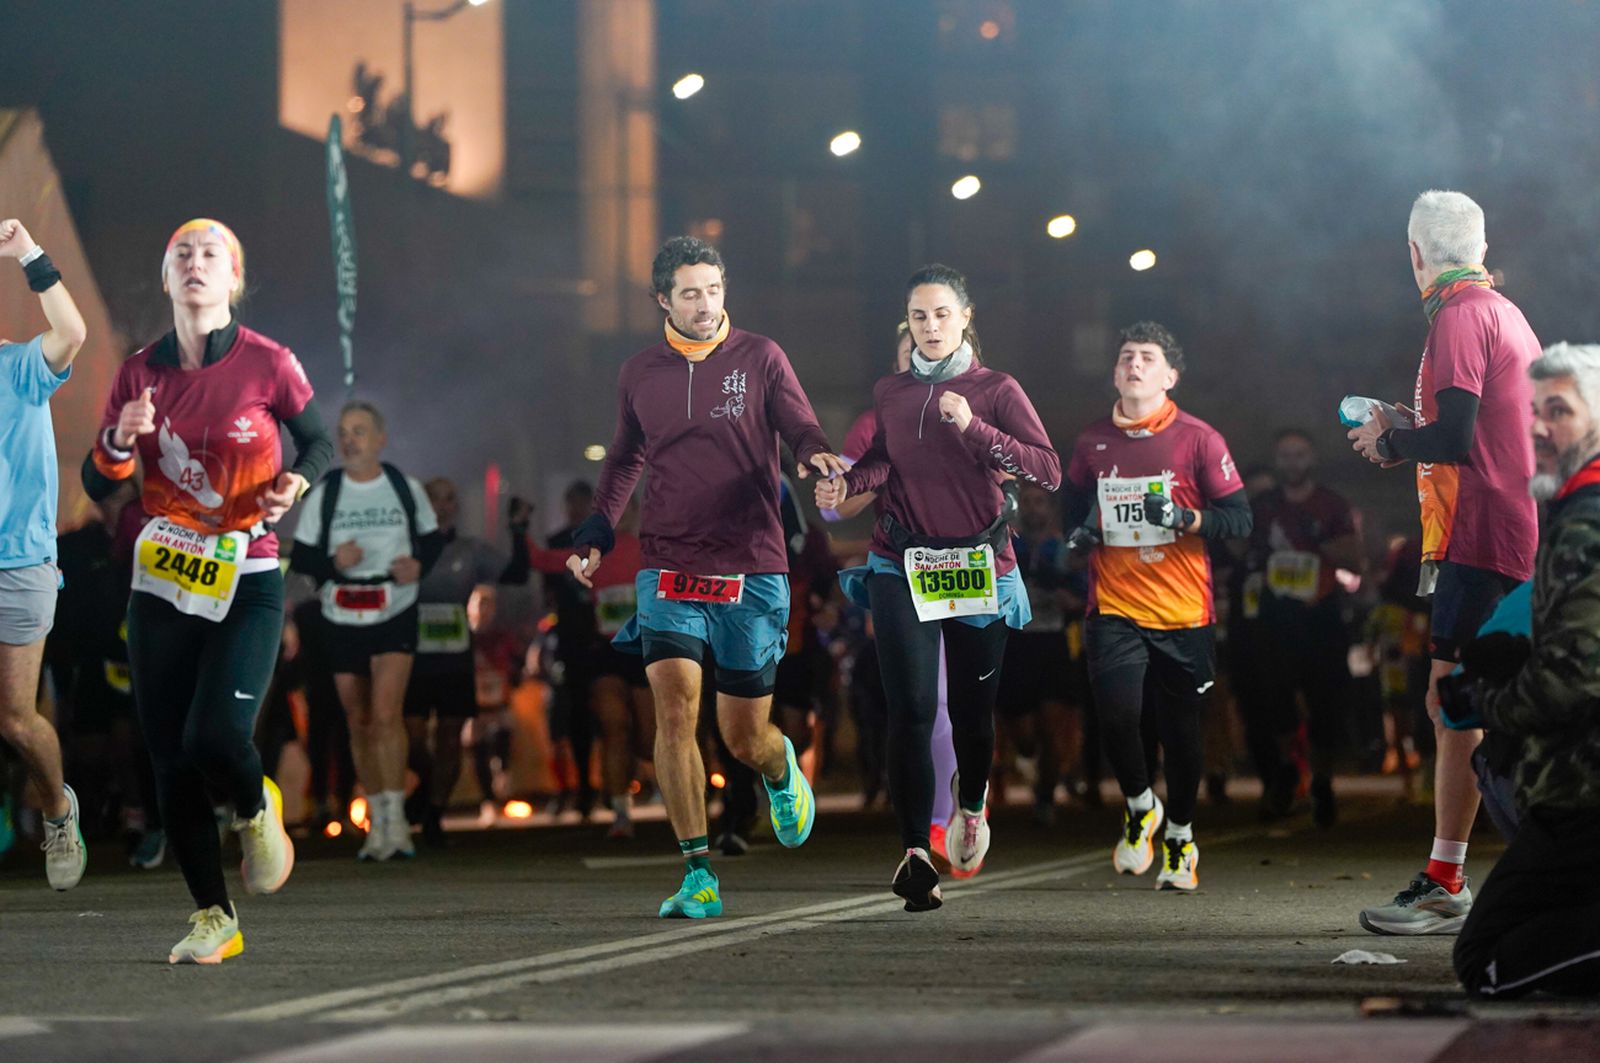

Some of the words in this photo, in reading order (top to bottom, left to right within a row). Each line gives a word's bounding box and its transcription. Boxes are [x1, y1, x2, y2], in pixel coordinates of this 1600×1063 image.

[180, 467, 204, 491] 43
[151, 532, 170, 545] SAN
[167, 526, 195, 540] NOCHE
[196, 534, 208, 544] DE
[155, 547, 219, 586] 2448
[914, 563, 931, 571] SAN
[925, 555, 948, 564] NOCHE
[950, 553, 960, 561] DE
[673, 574, 727, 597] 9732
[916, 569, 986, 594] 13500
